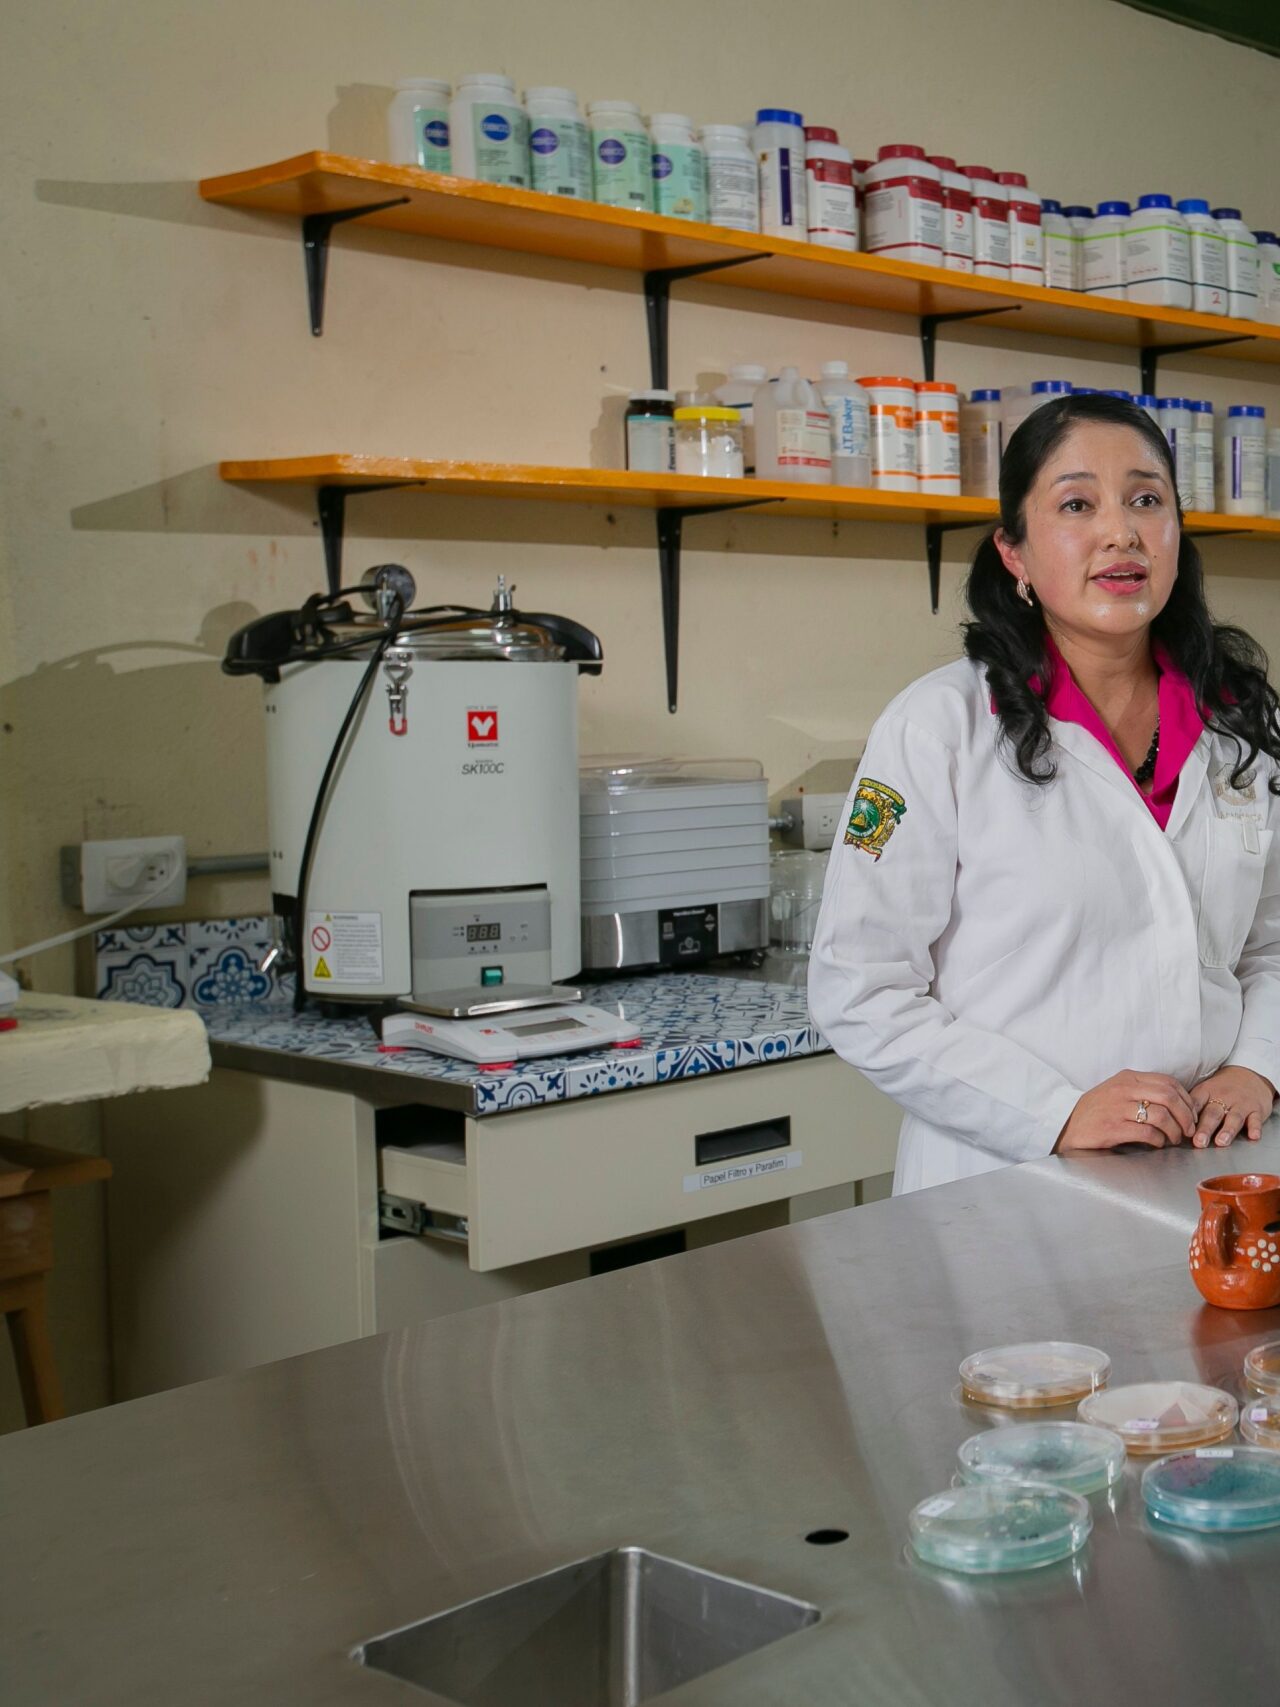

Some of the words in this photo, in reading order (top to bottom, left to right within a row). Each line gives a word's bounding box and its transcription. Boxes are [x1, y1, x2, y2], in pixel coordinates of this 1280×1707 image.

[461, 762, 505, 775] SK100C
[703, 1171, 726, 1185] Papel
[728, 1169, 748, 1180] Filtro
